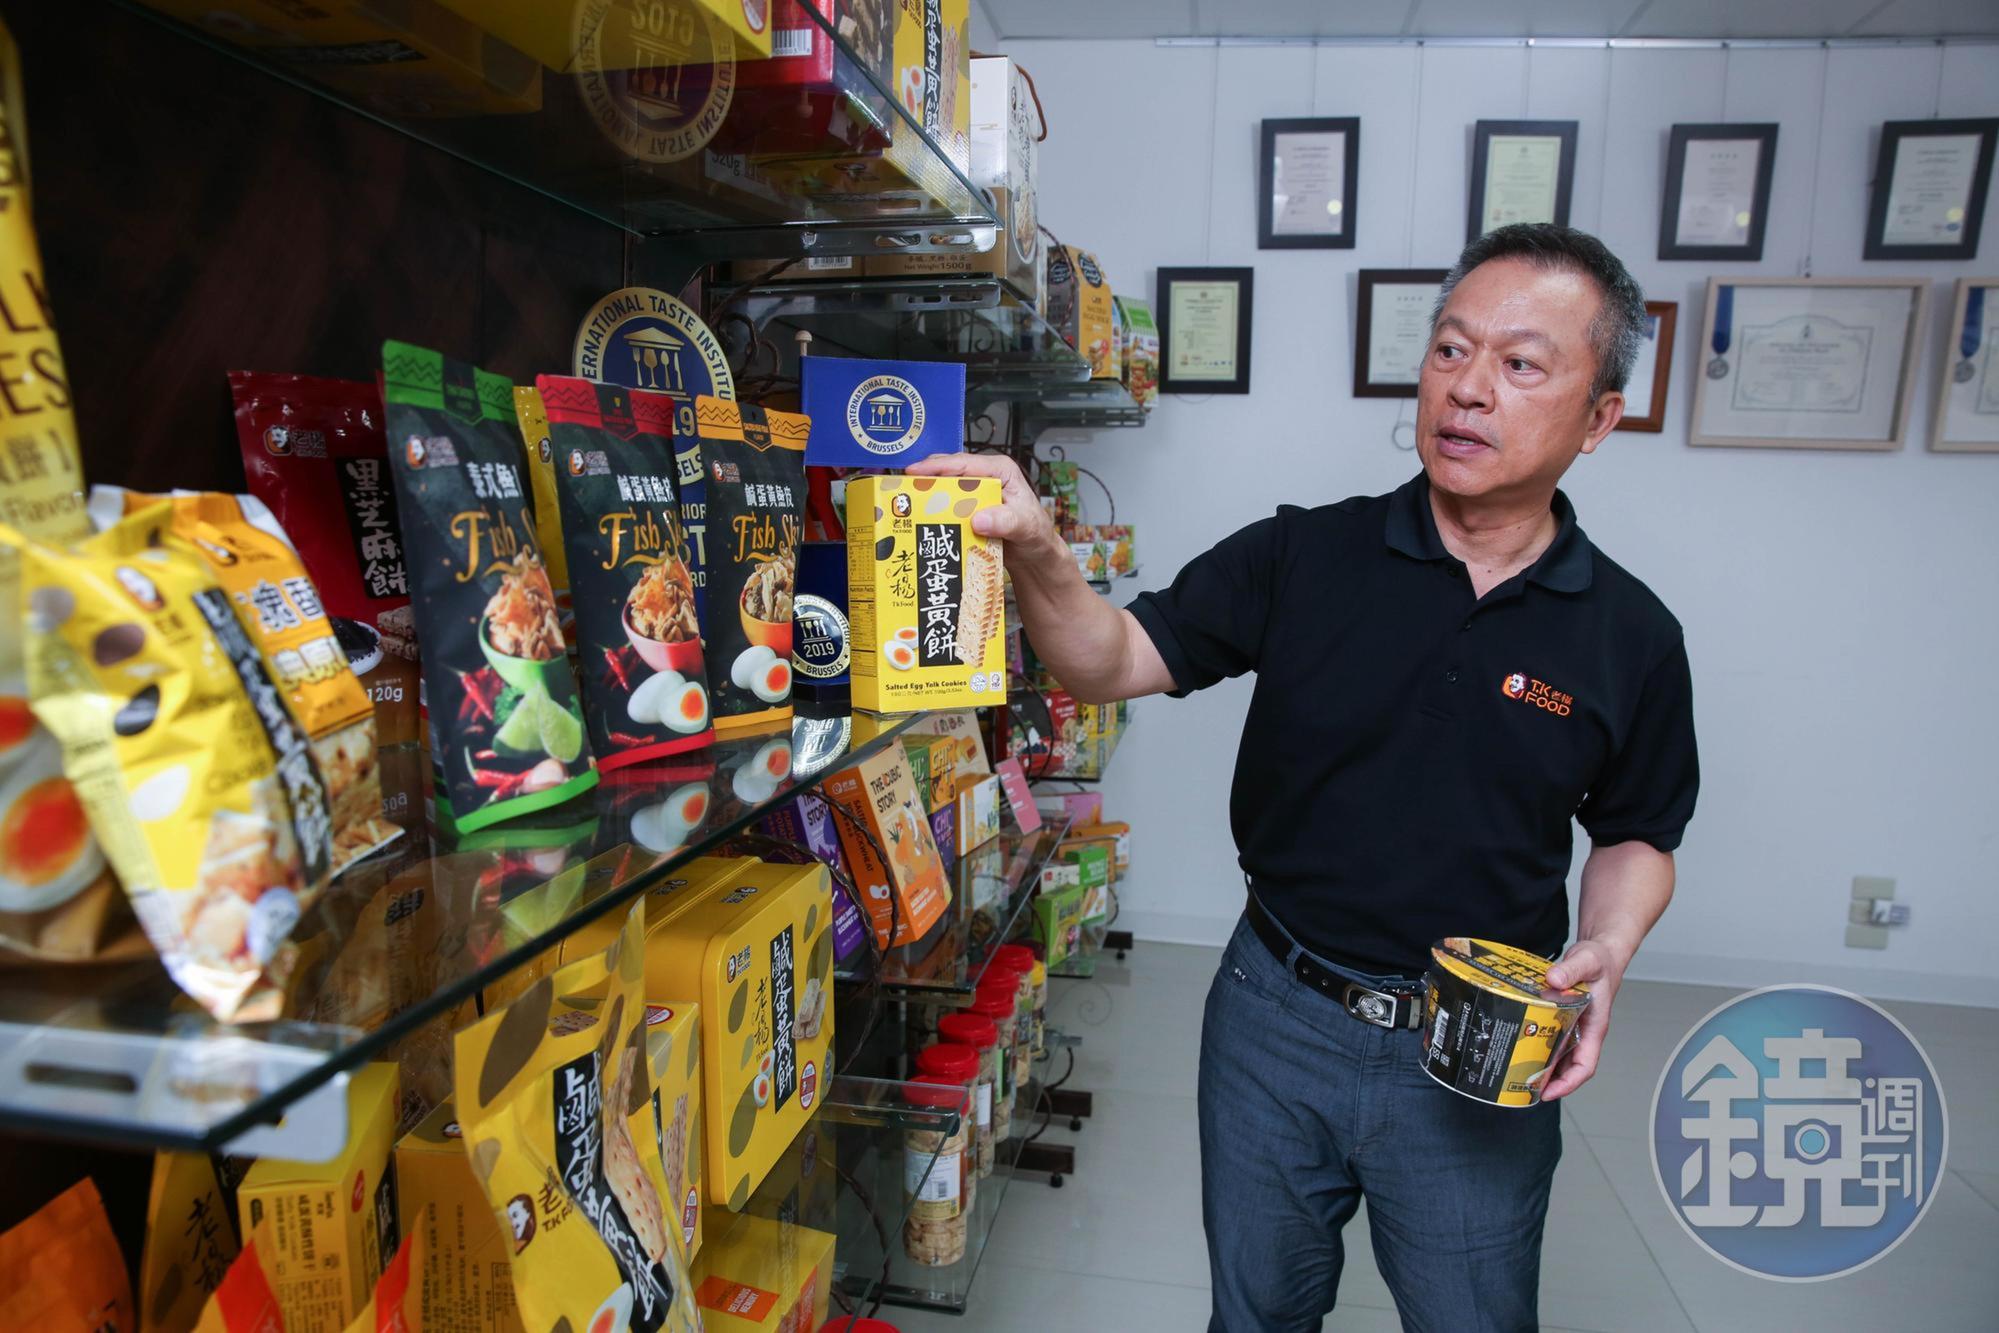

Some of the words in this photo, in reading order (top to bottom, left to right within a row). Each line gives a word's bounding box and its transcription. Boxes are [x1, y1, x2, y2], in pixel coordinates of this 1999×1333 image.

[648, 295, 697, 333] TASTE
[849, 378, 885, 428] INTERNATIONAL
[886, 378, 910, 393] TASTE
[908, 390, 922, 431] INSTITUTE
[866, 440, 904, 453] BRUSSELS
[599, 505, 661, 571] Fish
[732, 511, 777, 564] Fish
[918, 524, 961, 662] 鹹蛋黃餅
[803, 642, 835, 658] 2019
[805, 661, 844, 676] BRUSSELS
[366, 686, 404, 702] 120g
[910, 683, 924, 691] Egg
[1525, 691, 1571, 717] FOOD
[870, 778, 885, 795] THE
[876, 791, 898, 813] STORY
[806, 804, 829, 826] STORY
[771, 931, 796, 1100] 鹹蛋黃餅
